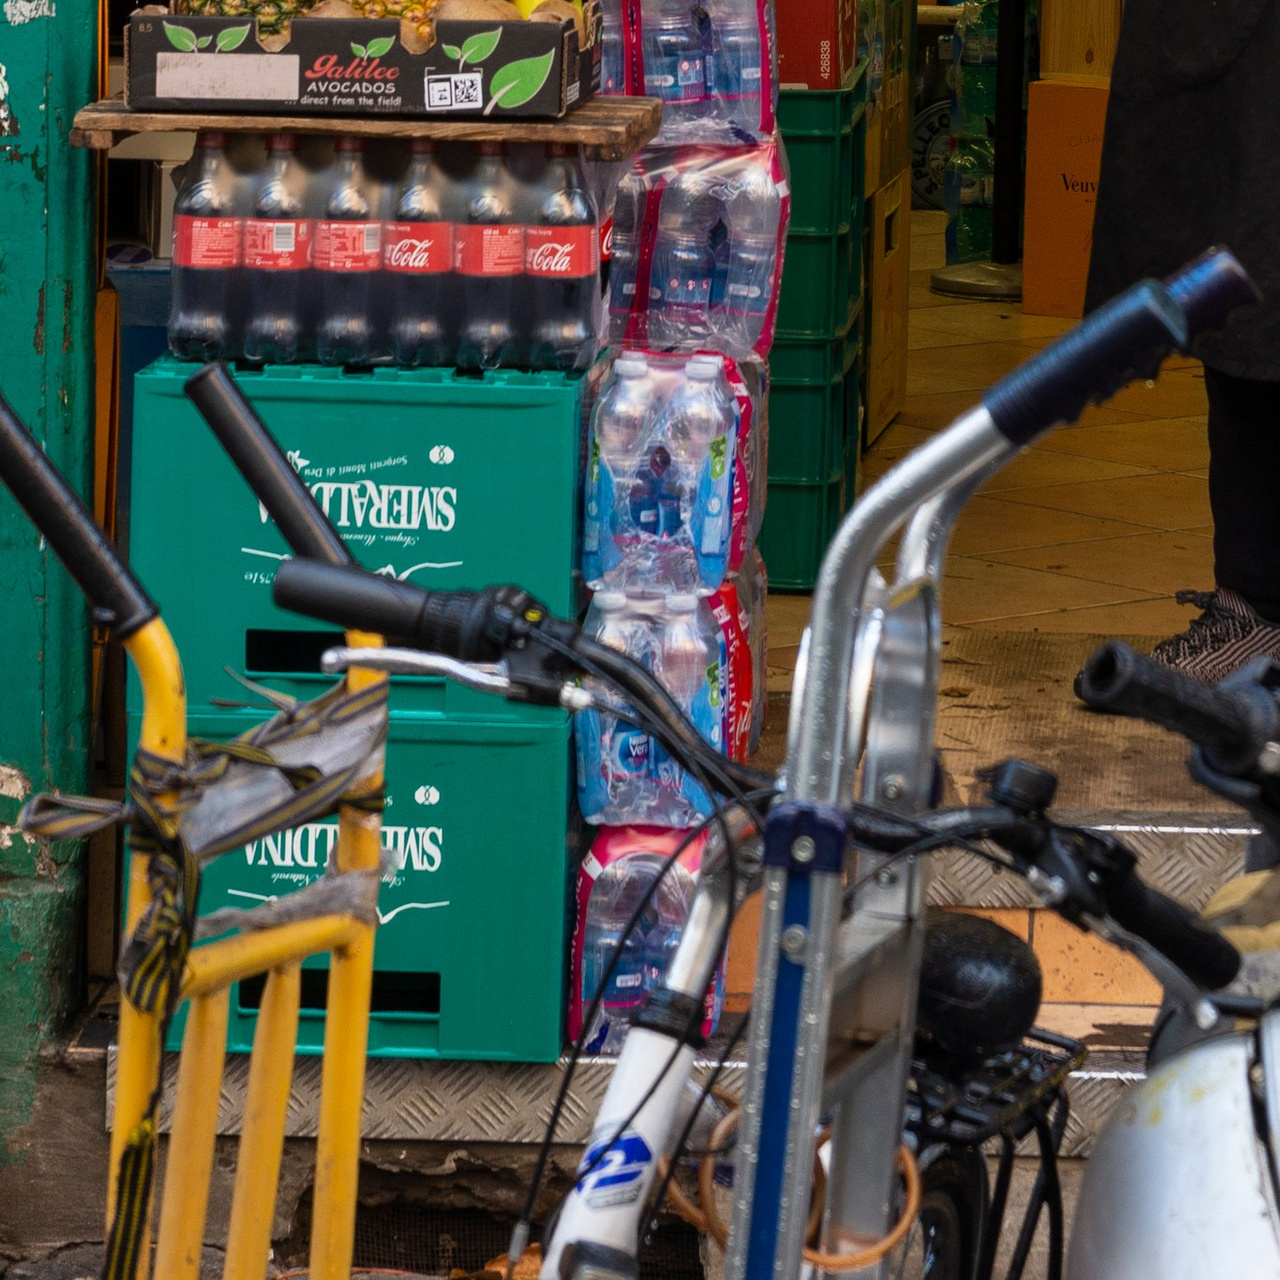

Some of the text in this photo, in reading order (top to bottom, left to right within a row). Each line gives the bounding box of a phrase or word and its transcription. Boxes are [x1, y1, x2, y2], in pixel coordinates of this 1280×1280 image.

[138, 23, 153, 33] 8.5
[819, 40, 831, 79] 426838
[307, 81, 396, 94] AVOCADOS
[300, 95, 330, 106] direct
[332, 95, 357, 106] from
[359, 95, 372, 106] the
[391, 238, 434, 269] Cola
[533, 242, 577, 272] Cola
[339, 463, 367, 475] Monti
[370, 454, 408, 470] Sorgenti
[304, 467, 323, 478] Deu
[385, 534, 419, 548] Acqua
[270, 872, 318, 888] Naturale
